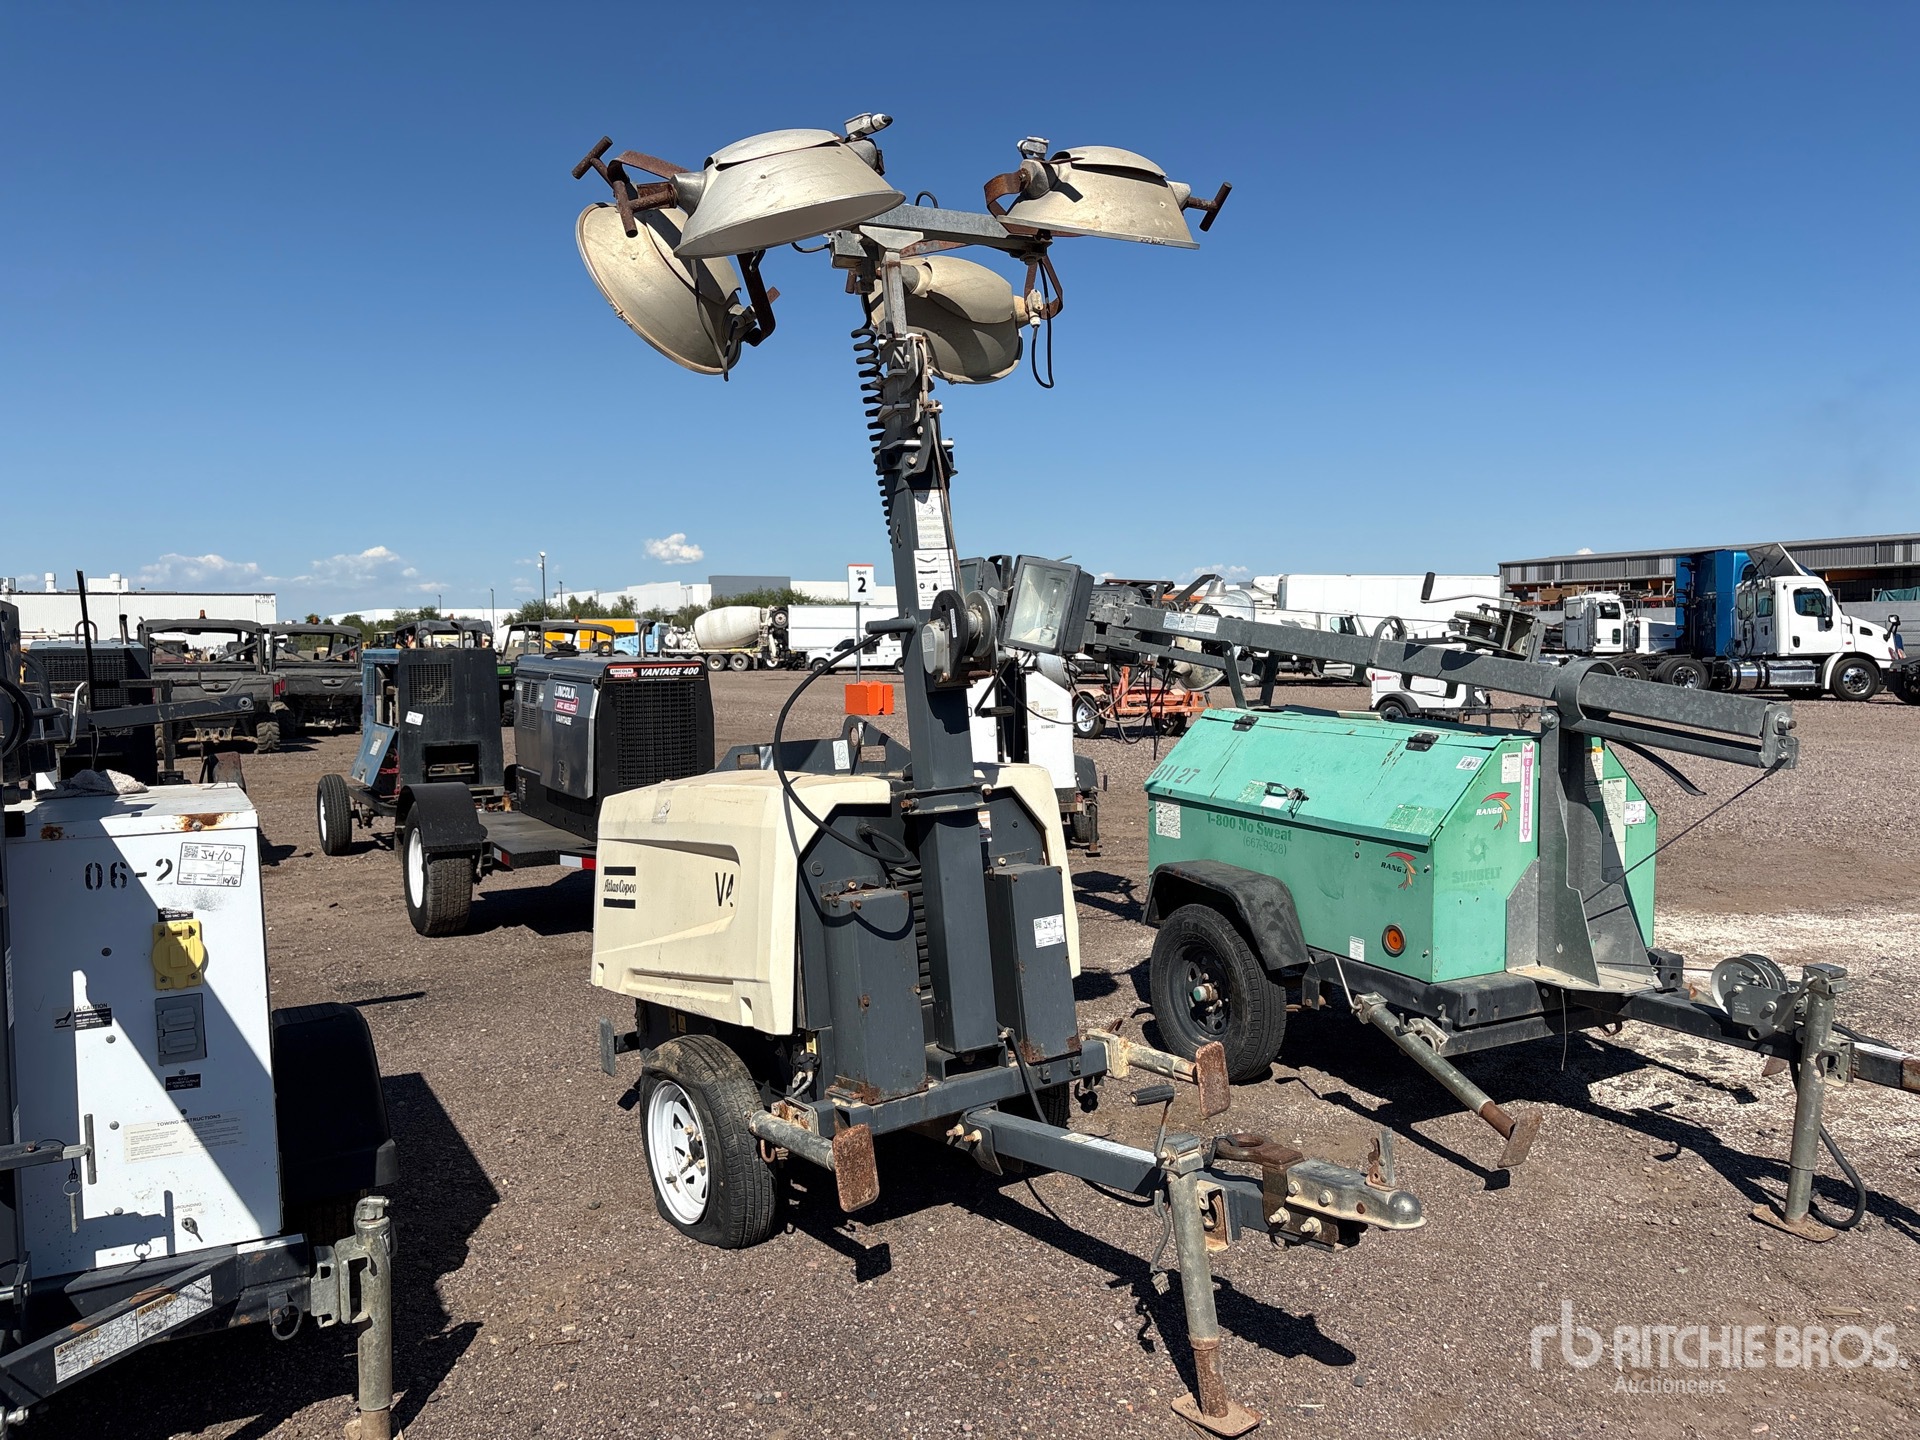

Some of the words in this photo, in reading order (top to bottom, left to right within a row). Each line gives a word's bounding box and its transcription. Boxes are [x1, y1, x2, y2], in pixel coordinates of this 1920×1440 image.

[857, 577, 866, 592] 2
[640, 667, 682, 677] VANTAGE
[682, 666, 700, 676] 400
[554, 685, 576, 700] LINCOLN
[555, 713, 573, 726] VANTAGE
[1475, 806, 1503, 816] RANGO
[1206, 811, 1236, 830] 1-800
[1238, 818, 1254, 834] No
[1256, 822, 1293, 842] Sweat
[603, 878, 618, 893] Atlas
[619, 879, 637, 896] Copco
[81, 1002, 108, 1011] CAUTION
[180, 1114, 221, 1123] INSTRUCTIONS
[63, 1332, 95, 1351] WARNING
